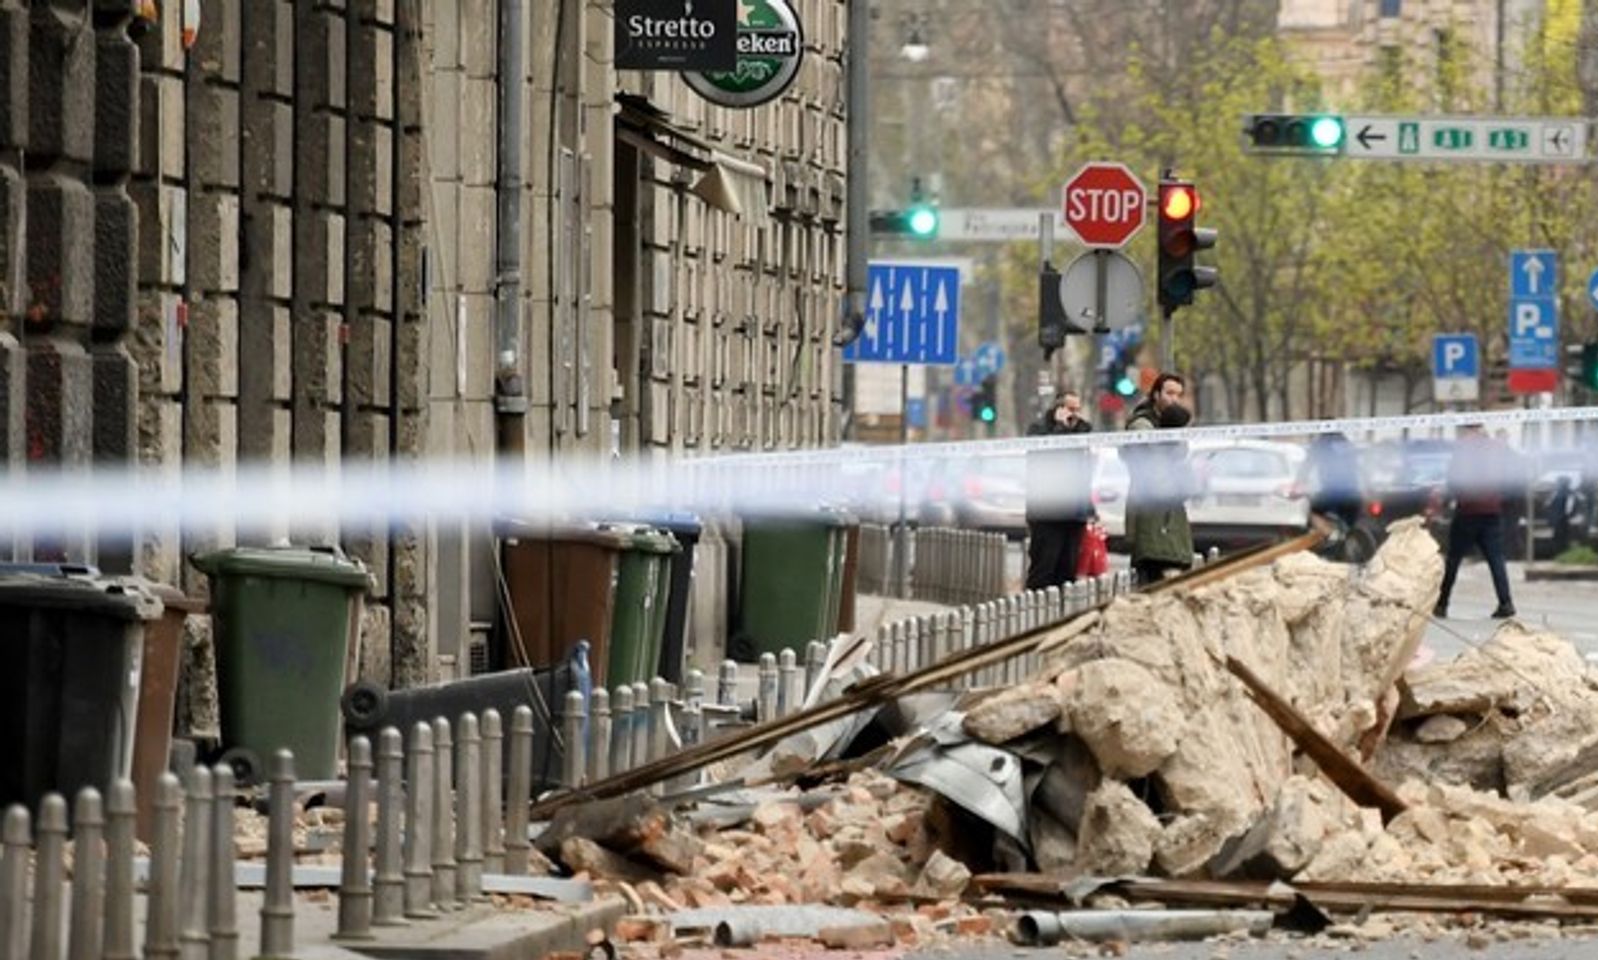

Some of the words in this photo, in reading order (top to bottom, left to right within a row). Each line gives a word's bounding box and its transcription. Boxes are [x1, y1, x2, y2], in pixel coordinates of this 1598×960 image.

[629, 15, 715, 37] Stretto
[737, 32, 792, 52] eken
[1069, 188, 1139, 222] STOP
[1516, 303, 1541, 336] P
[1444, 342, 1466, 371] P
